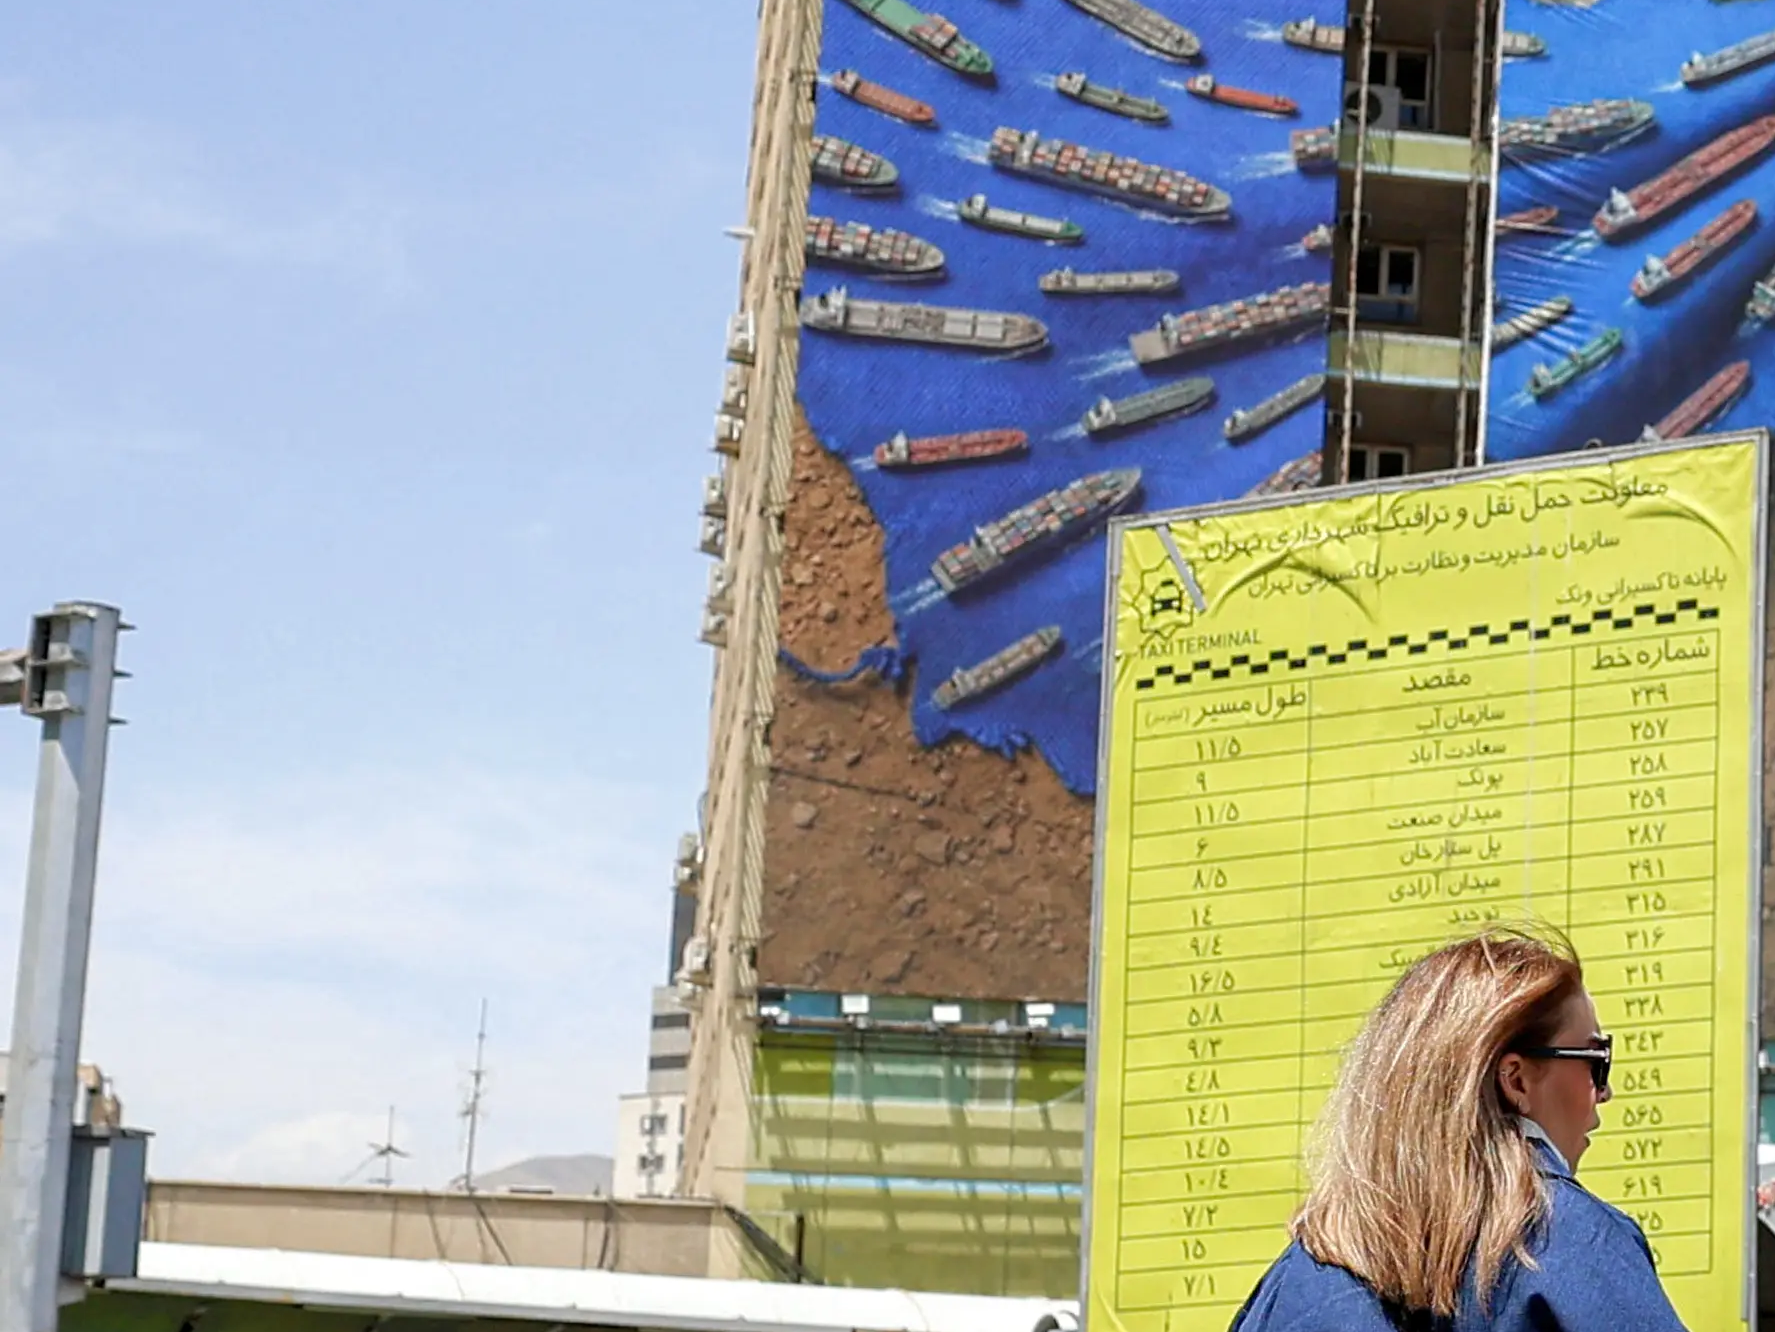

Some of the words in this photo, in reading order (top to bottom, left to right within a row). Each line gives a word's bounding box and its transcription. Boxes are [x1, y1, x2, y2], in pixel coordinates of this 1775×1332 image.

[1580, 475, 1668, 508] معاونت
[1374, 502, 1449, 535] ترافیک
[1453, 506, 1468, 531] و
[1473, 492, 1515, 528] نقل
[1203, 532, 1262, 562] تهران
[1268, 516, 1369, 553] شهرداری
[1552, 530, 1620, 559] سازمان
[1473, 542, 1547, 568] مدیریت
[1248, 574, 1294, 599] تهران
[1596, 571, 1680, 605] تاکسیرانی
[1684, 566, 1727, 592] پایانه
[1556, 584, 1593, 607] ونک
[1140, 641, 1173, 660] TAXI
[1178, 628, 1262, 654] TERMINAL
[1636, 637, 1710, 670] شماره
[1591, 646, 1632, 670] خط
[1402, 668, 1472, 693] مقصد
[1256, 684, 1307, 719] طول
[1630, 682, 1669, 706] ۲۳۹
[1193, 701, 1252, 727] مسیر
[1415, 706, 1442, 734] آب
[1443, 704, 1506, 730] سازمان
[1630, 718, 1669, 741] ۲۵۷
[1408, 739, 1442, 765] آباد
[1444, 738, 1507, 760] سعادت
[1630, 752, 1669, 776] ۲۵۸
[1628, 787, 1667, 810] ۲۵۹
[1387, 814, 1443, 831] صنعت
[1448, 804, 1503, 828] میدان
[1627, 822, 1666, 846] ۲۸۷
[1628, 858, 1665, 881] ۲۹۱
[1388, 870, 1442, 903] آزادی
[1448, 873, 1502, 897] میدان
[1626, 891, 1666, 915] ۳۱۵
[1625, 925, 1665, 950] ۳۱۶
[1625, 961, 1664, 986] ۳۱۹
[1623, 1104, 1663, 1128] ۵۶۵
[1623, 1138, 1663, 1161] ۵۷۲
[1623, 1175, 1663, 1198] ۶۱۹
[1634, 1210, 1664, 1231] ۲۵
